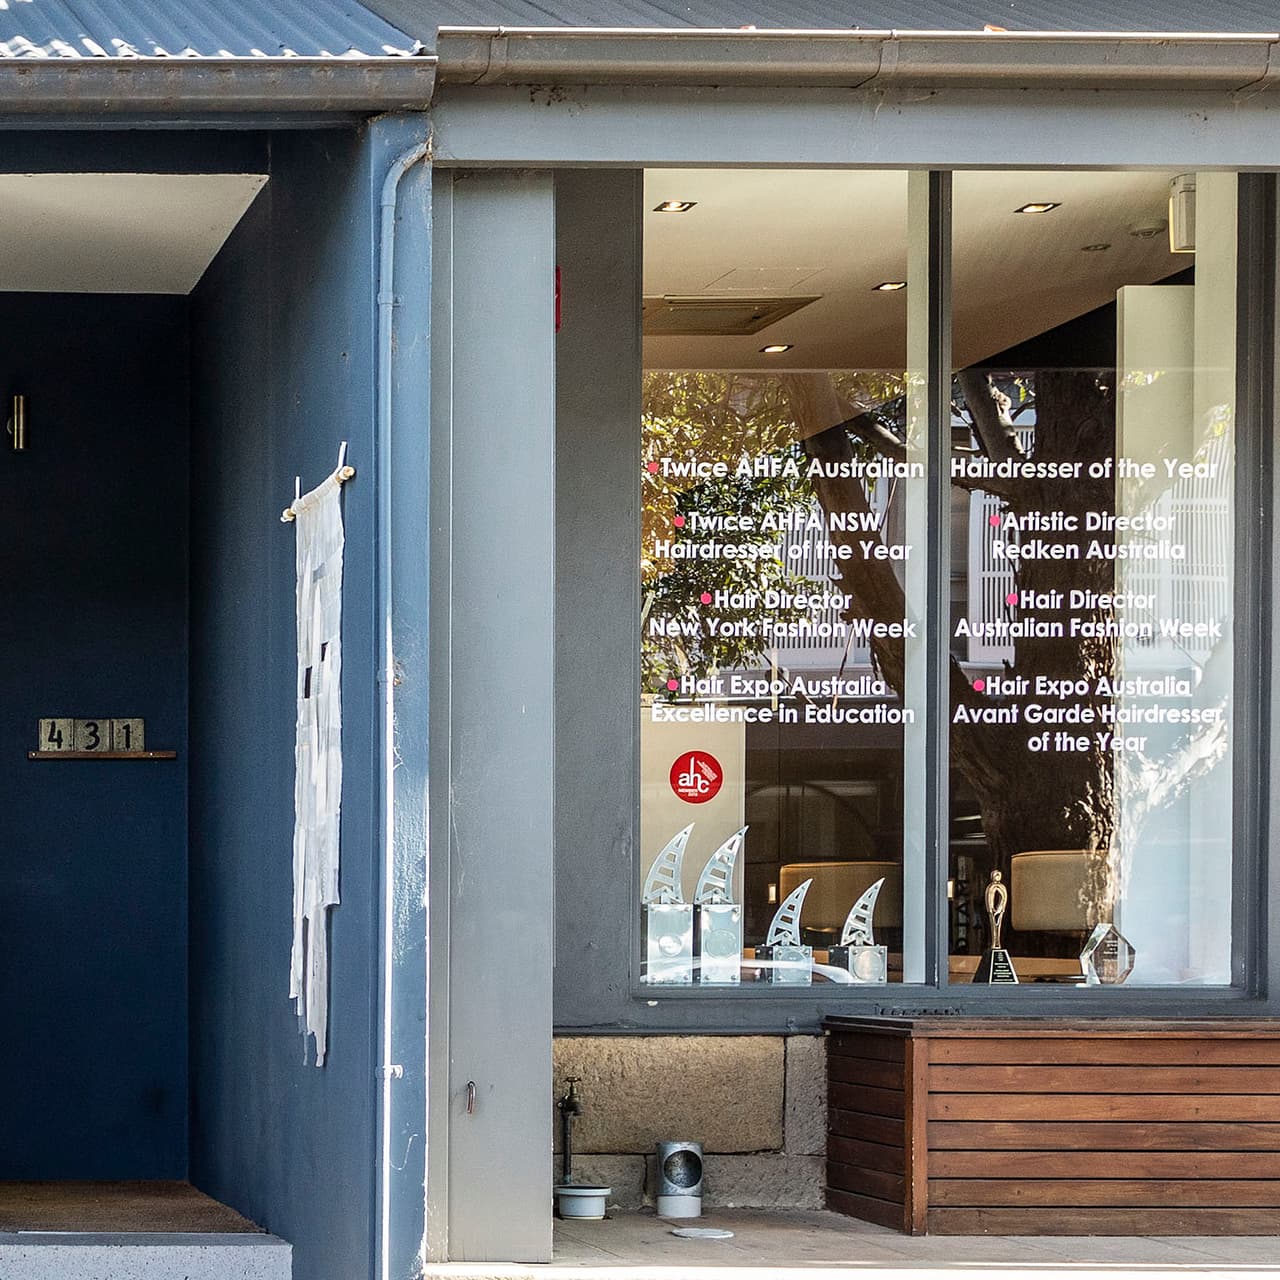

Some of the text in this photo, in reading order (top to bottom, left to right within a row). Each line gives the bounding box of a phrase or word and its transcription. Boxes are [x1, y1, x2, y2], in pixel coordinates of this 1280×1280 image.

[660, 458, 925, 478] Twice AHFA Australian
[950, 457, 1219, 478] Hairdresser of the Year
[688, 511, 882, 532] Twice AHFA NSW
[1002, 511, 1176, 532] Artistic Director
[655, 539, 913, 560] Hairdresser of the Year
[992, 539, 1185, 560] Redken Australia
[714, 589, 853, 610] Hair Director
[1020, 589, 1156, 610] Hair Director
[649, 618, 917, 638] New York Fashion Week
[954, 618, 1222, 638] Australian Fashion Week
[681, 675, 886, 698] Hair Expo Australia
[986, 675, 1191, 699] Hair Expo Australia
[650, 704, 915, 724] Excellence in Education
[952, 703, 1223, 724] Avant Garde Hairdresser
[47, 720, 131, 751] 431
[1028, 731, 1148, 752] of the Year
[678, 756, 710, 793] ahc
